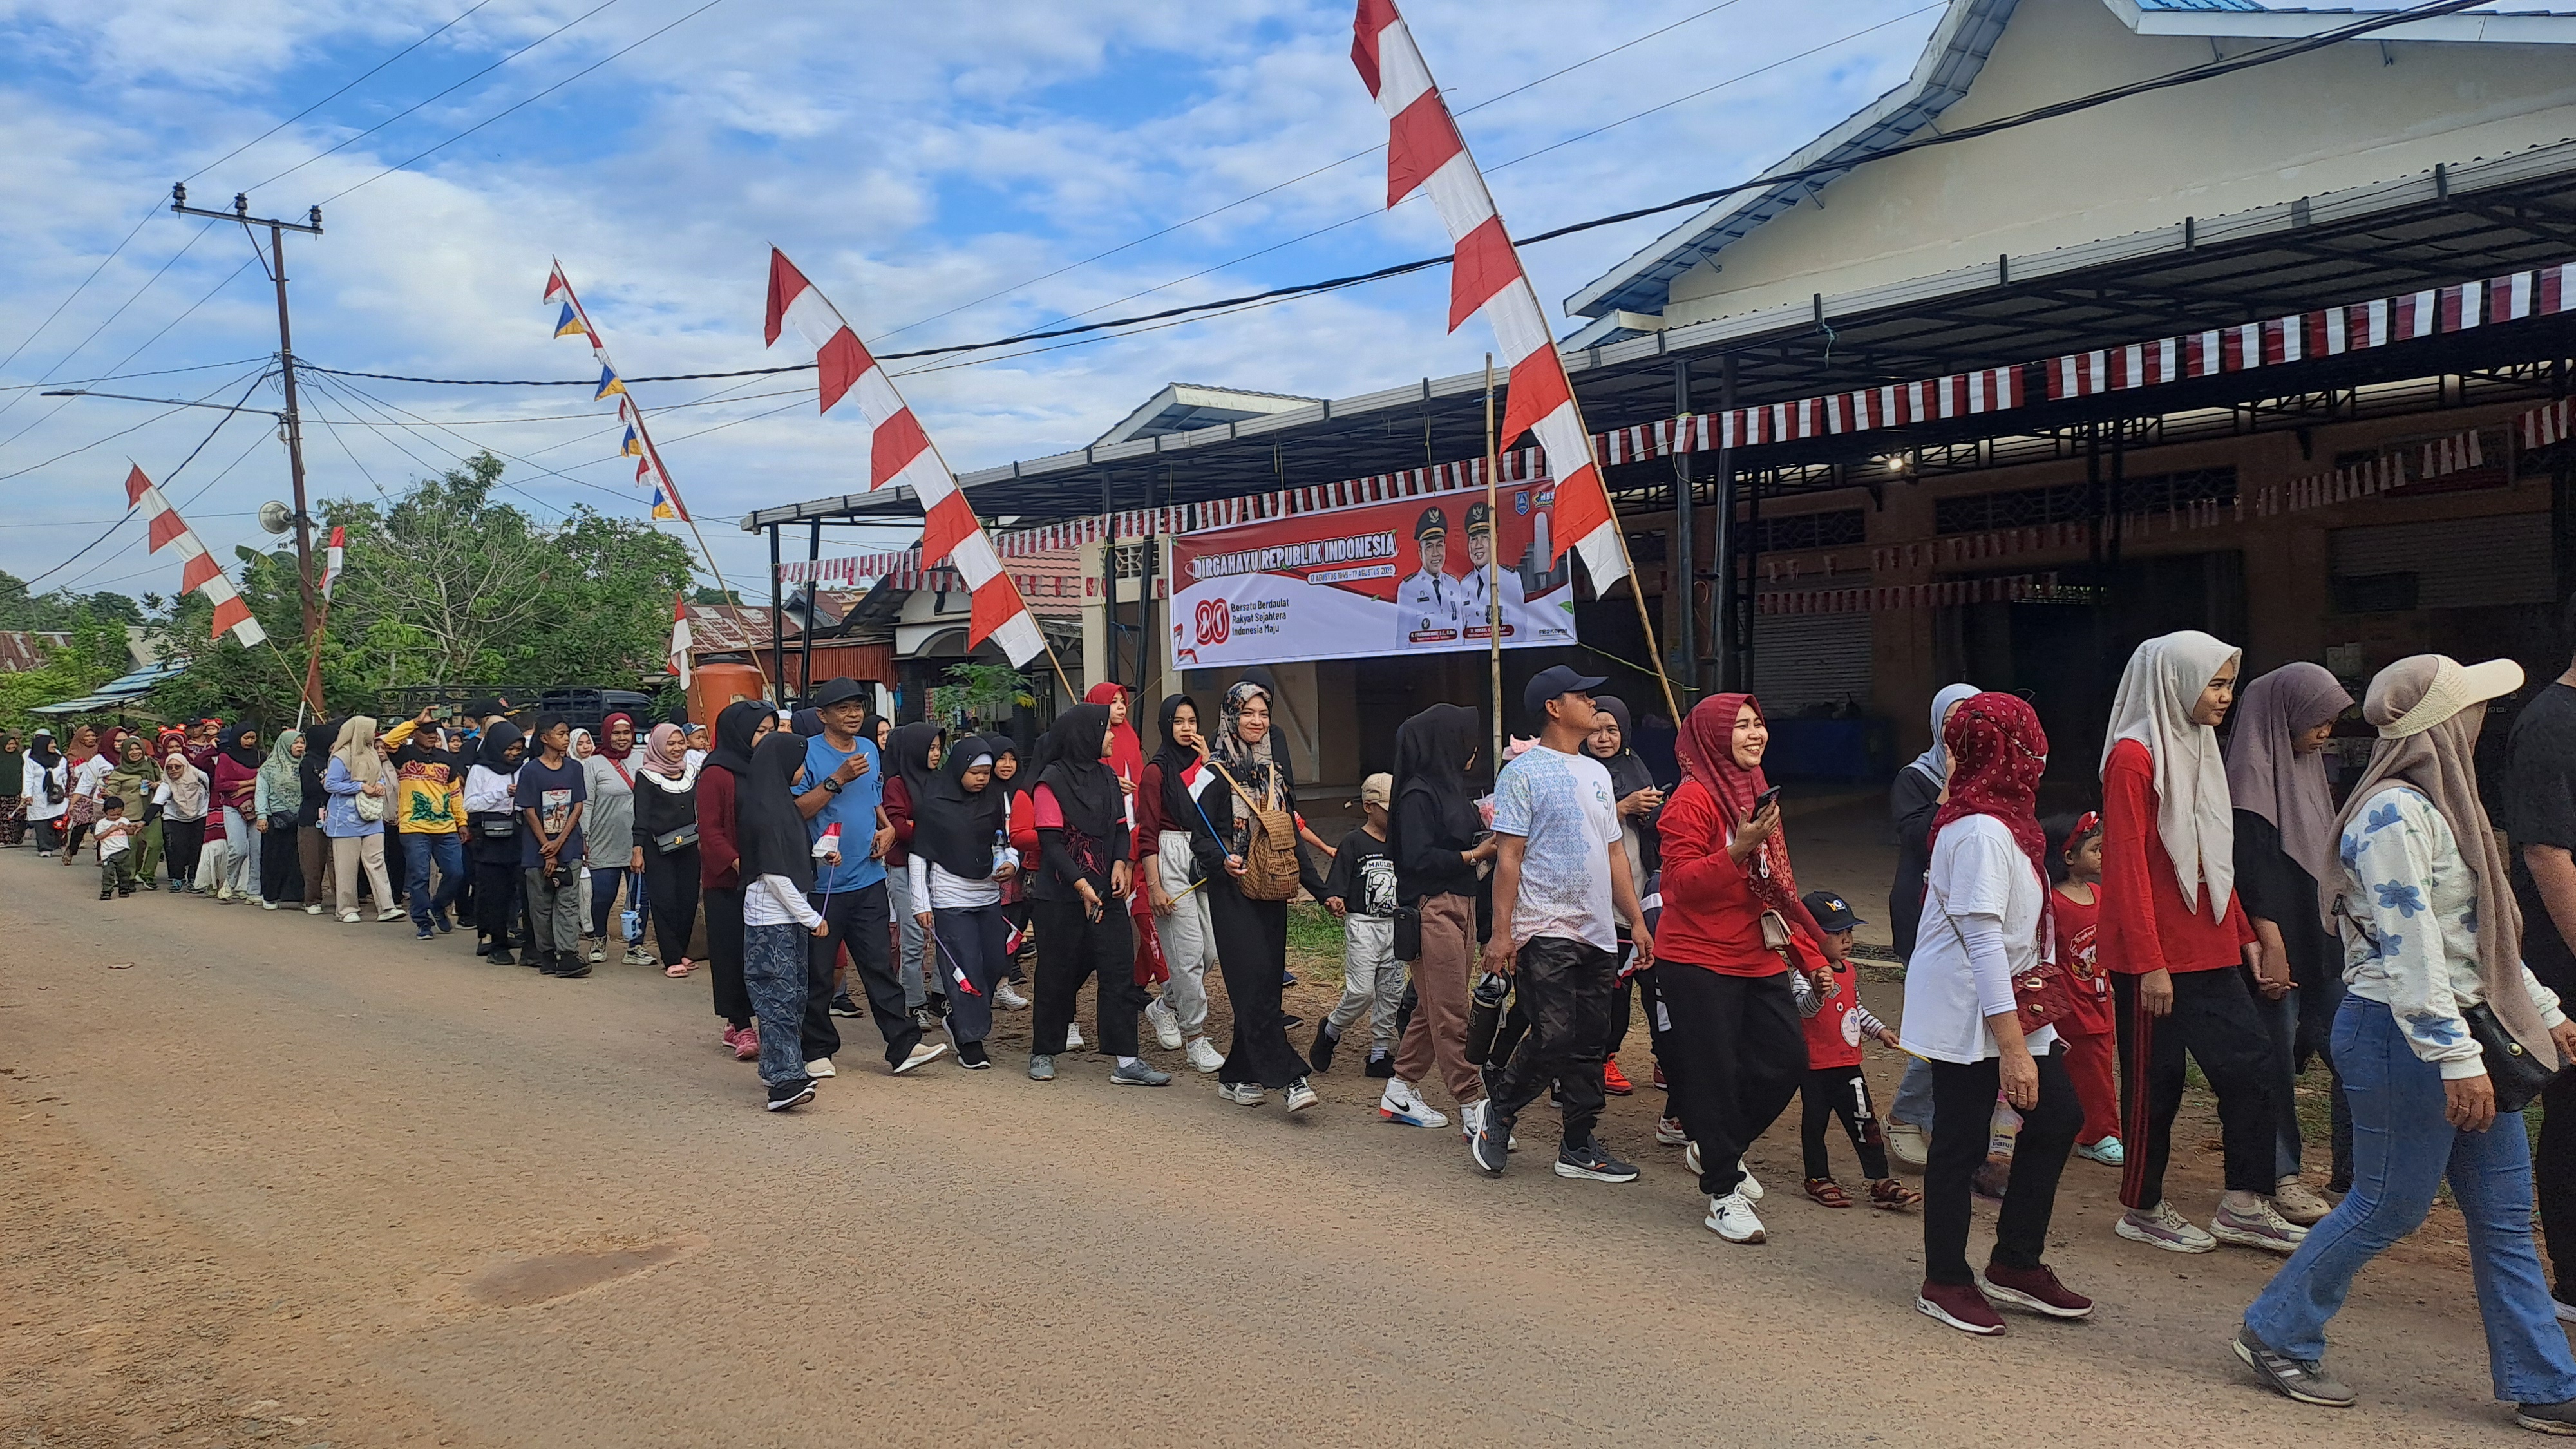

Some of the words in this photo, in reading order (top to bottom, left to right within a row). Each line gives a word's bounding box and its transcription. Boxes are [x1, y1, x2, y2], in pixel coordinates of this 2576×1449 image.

[1193, 551, 1259, 579] DIRGAHAYU
[1261, 542, 1322, 570] REPUBLIK
[1324, 533, 1396, 562] INDONESIA
[1316, 573, 1337, 582] AGUSTUS
[1358, 567, 1379, 577] AGUSTUS
[1381, 566, 1393, 574] 2025
[1231, 602, 1256, 612] Bersatu
[1258, 598, 1289, 610] Berdaulat
[1195, 598, 1229, 645] 80
[1232, 614, 1254, 625] Rakyat
[1255, 612, 1287, 623] Sejahtera
[1232, 625, 1263, 636] Indonesia
[1264, 624, 1280, 635] Maju
